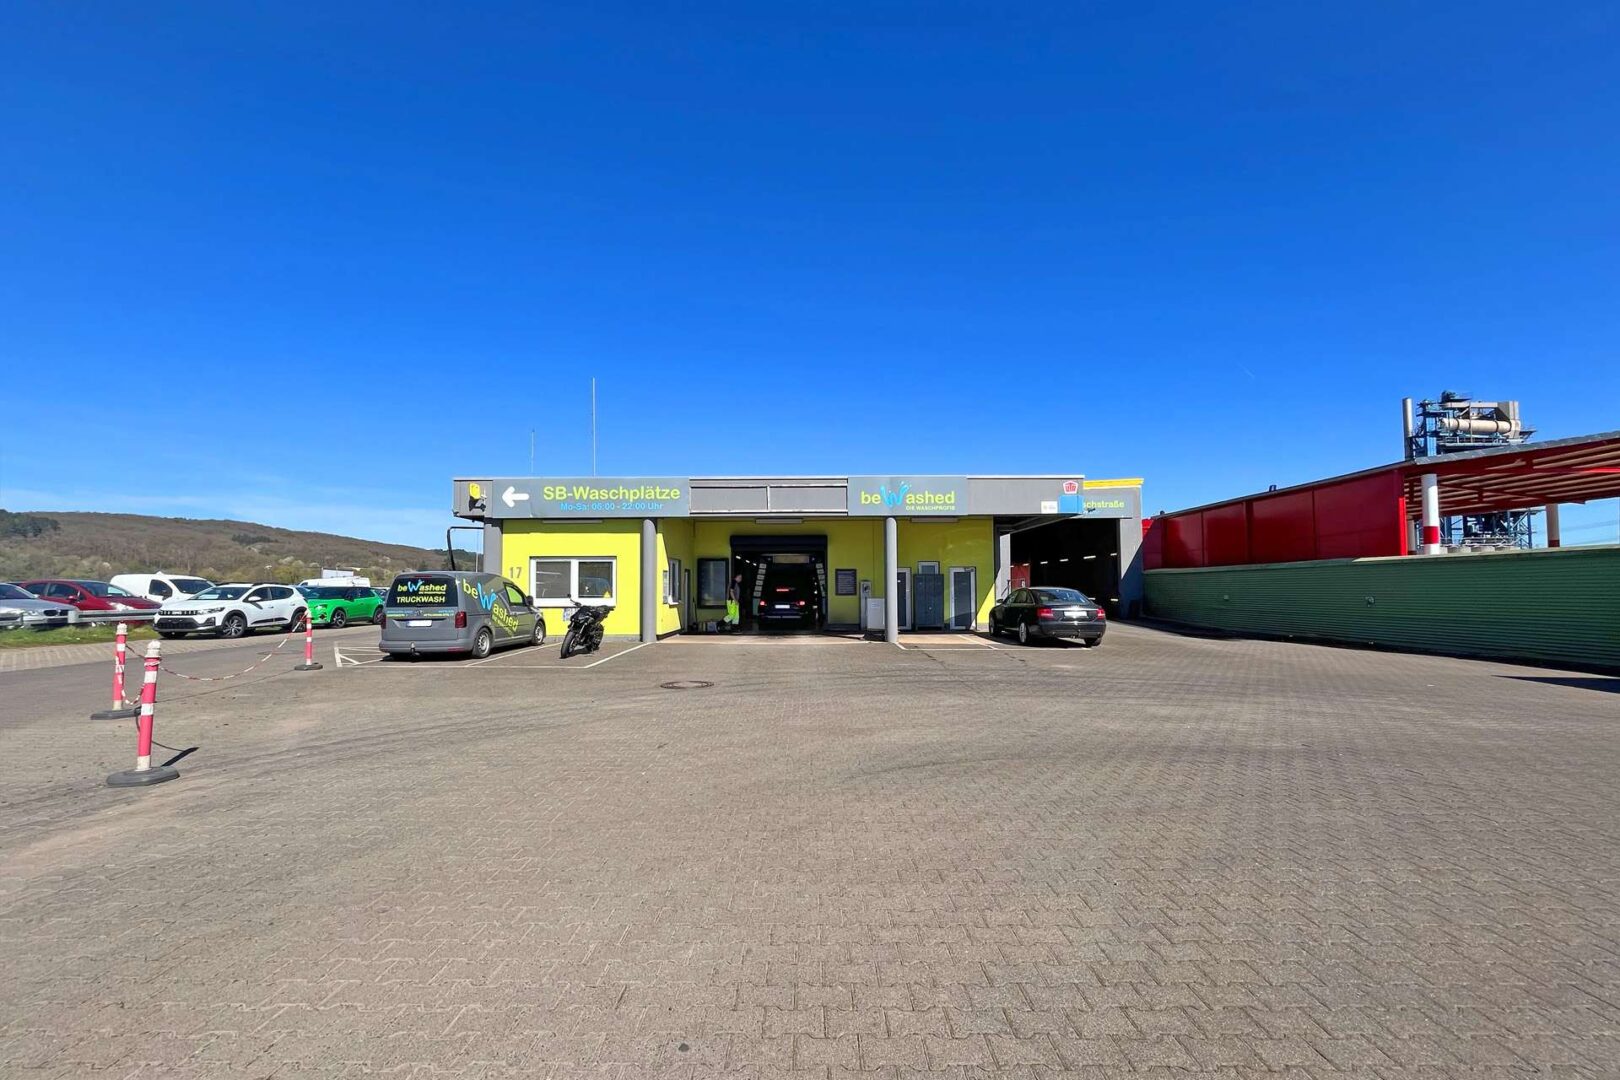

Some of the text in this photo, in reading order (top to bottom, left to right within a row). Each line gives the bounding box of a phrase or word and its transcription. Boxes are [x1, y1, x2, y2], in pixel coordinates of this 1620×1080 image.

[543, 486, 681, 502] SB-Waschplätze
[861, 481, 955, 507] beWashed
[622, 502, 645, 510] 22:00
[648, 502, 663, 510] Uhr
[1083, 500, 1125, 508] schstraße
[510, 566, 522, 579] 17
[397, 579, 447, 592] beWashed
